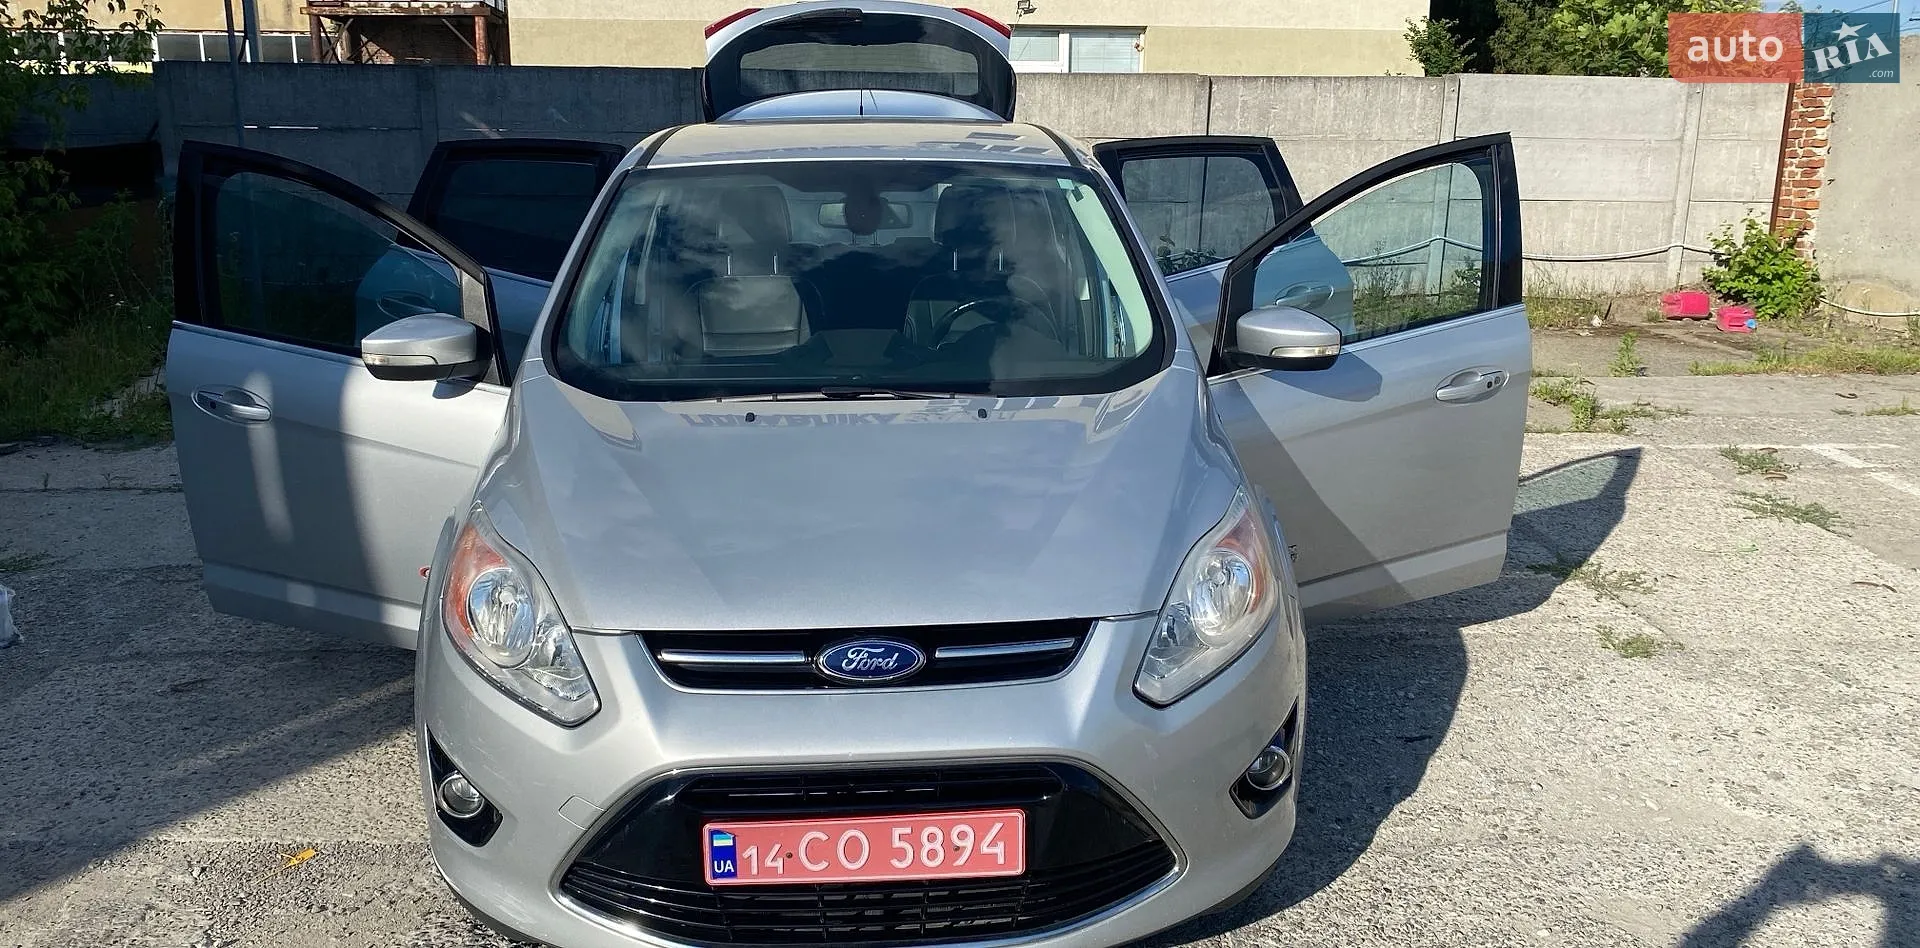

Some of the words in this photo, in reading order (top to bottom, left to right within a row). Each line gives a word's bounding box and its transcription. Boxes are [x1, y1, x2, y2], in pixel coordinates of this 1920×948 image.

[841, 646, 899, 672] Ford
[742, 843, 785, 875] 14
[889, 822, 1005, 869] 5894
[713, 860, 735, 874] UA
